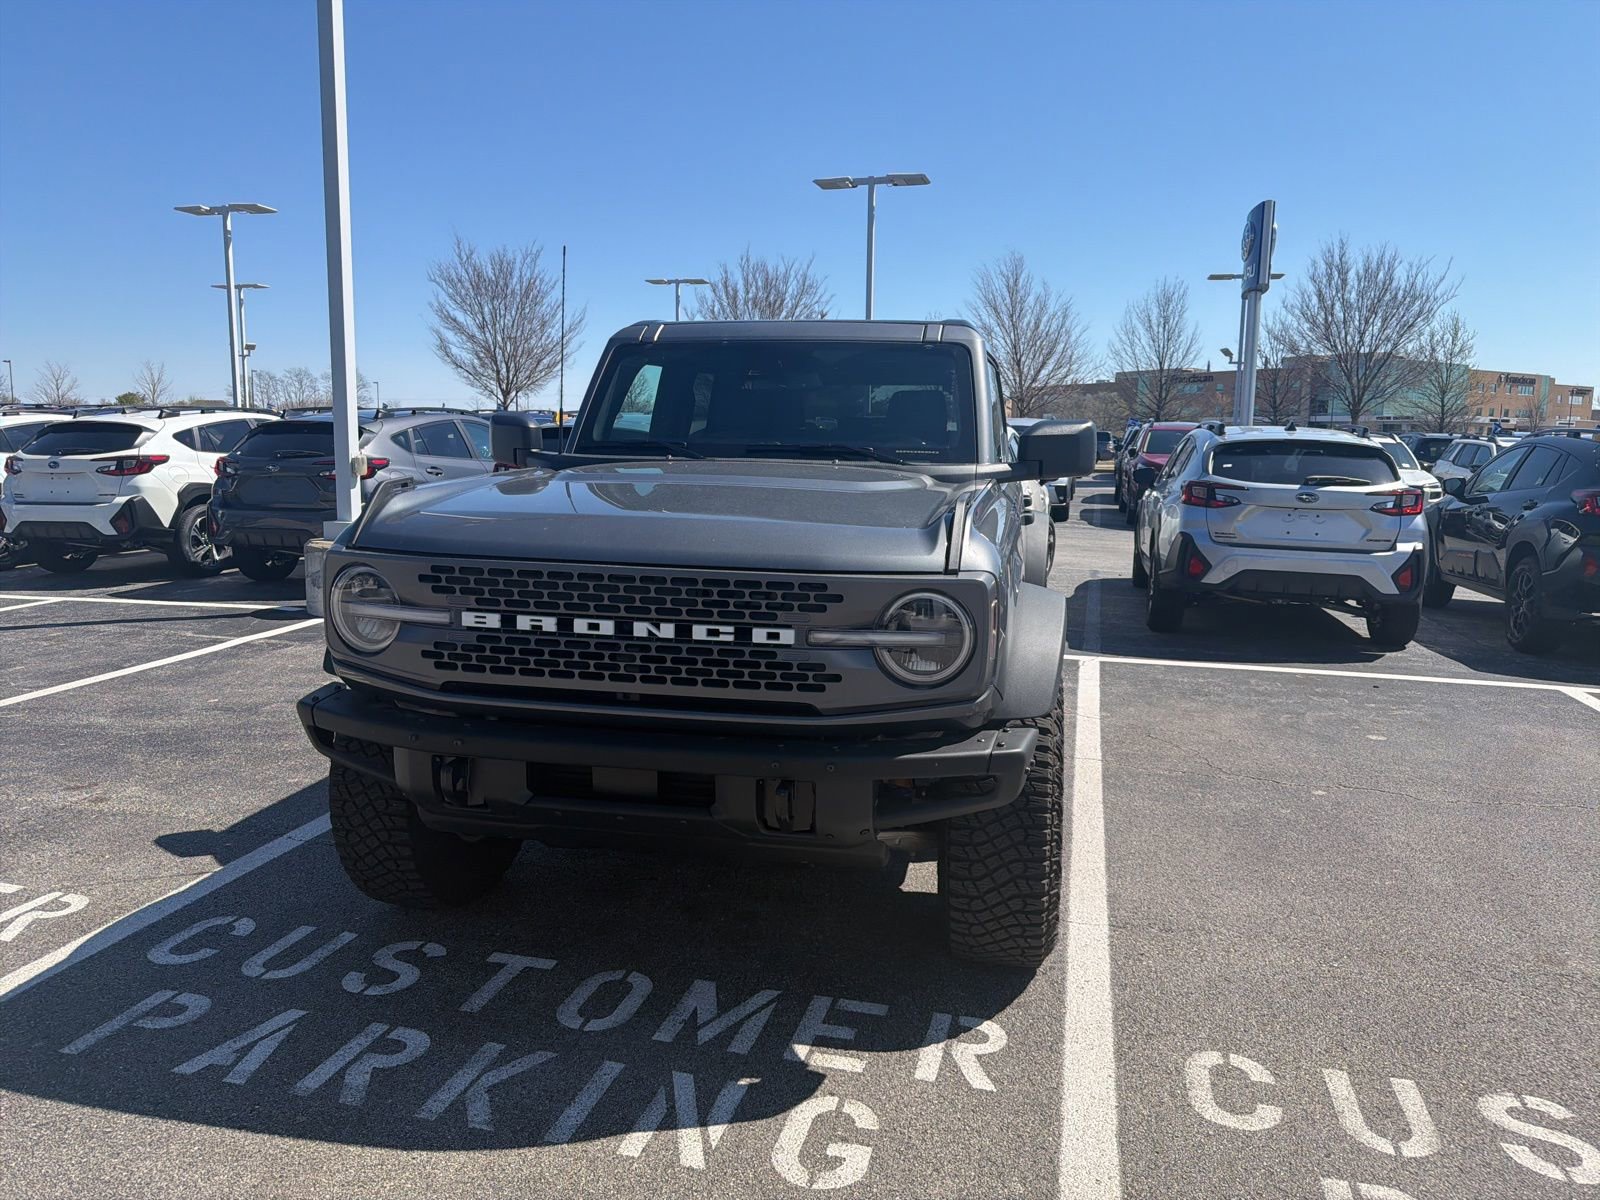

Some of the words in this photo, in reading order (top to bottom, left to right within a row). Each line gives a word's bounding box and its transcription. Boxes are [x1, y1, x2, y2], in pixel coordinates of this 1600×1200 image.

[461, 611, 795, 645] BRONCO
[59, 989, 880, 1190] PARKING
[146, 914, 1009, 1093] CUSTOMER
